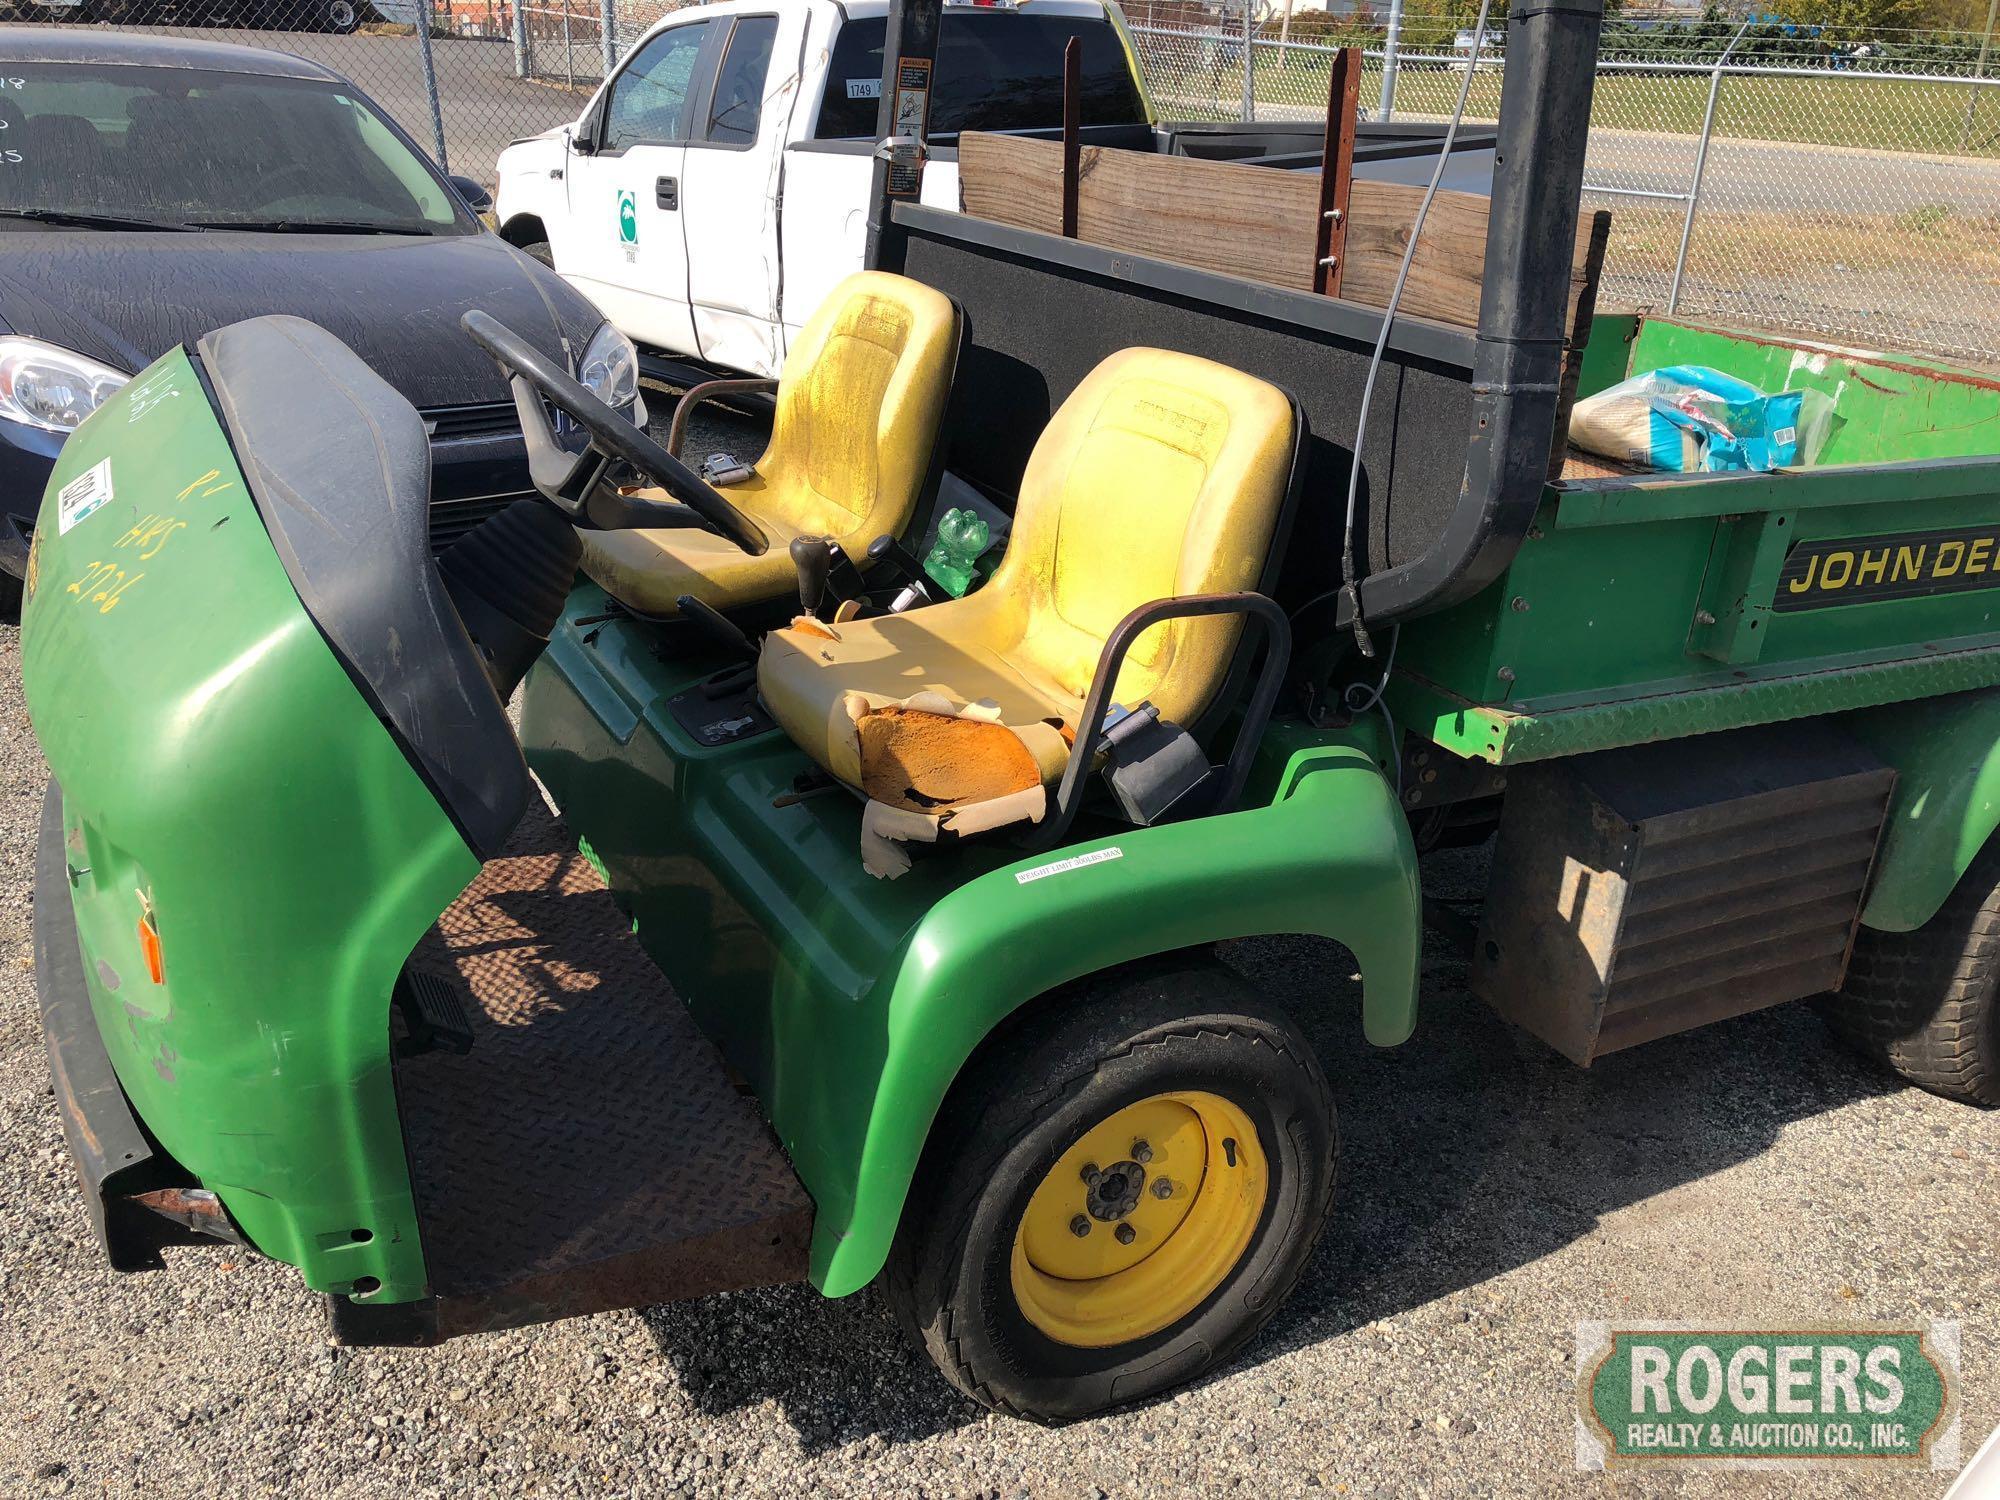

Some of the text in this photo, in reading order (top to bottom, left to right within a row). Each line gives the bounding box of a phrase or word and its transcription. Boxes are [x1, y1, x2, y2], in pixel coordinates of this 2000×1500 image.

[850, 84, 872, 97] 1749
[1789, 537, 2000, 593] JOHN DE
[1018, 867, 1052, 881] WEIGHT
[1052, 861, 1073, 872] LIMIT
[1103, 848, 1121, 859] MAX
